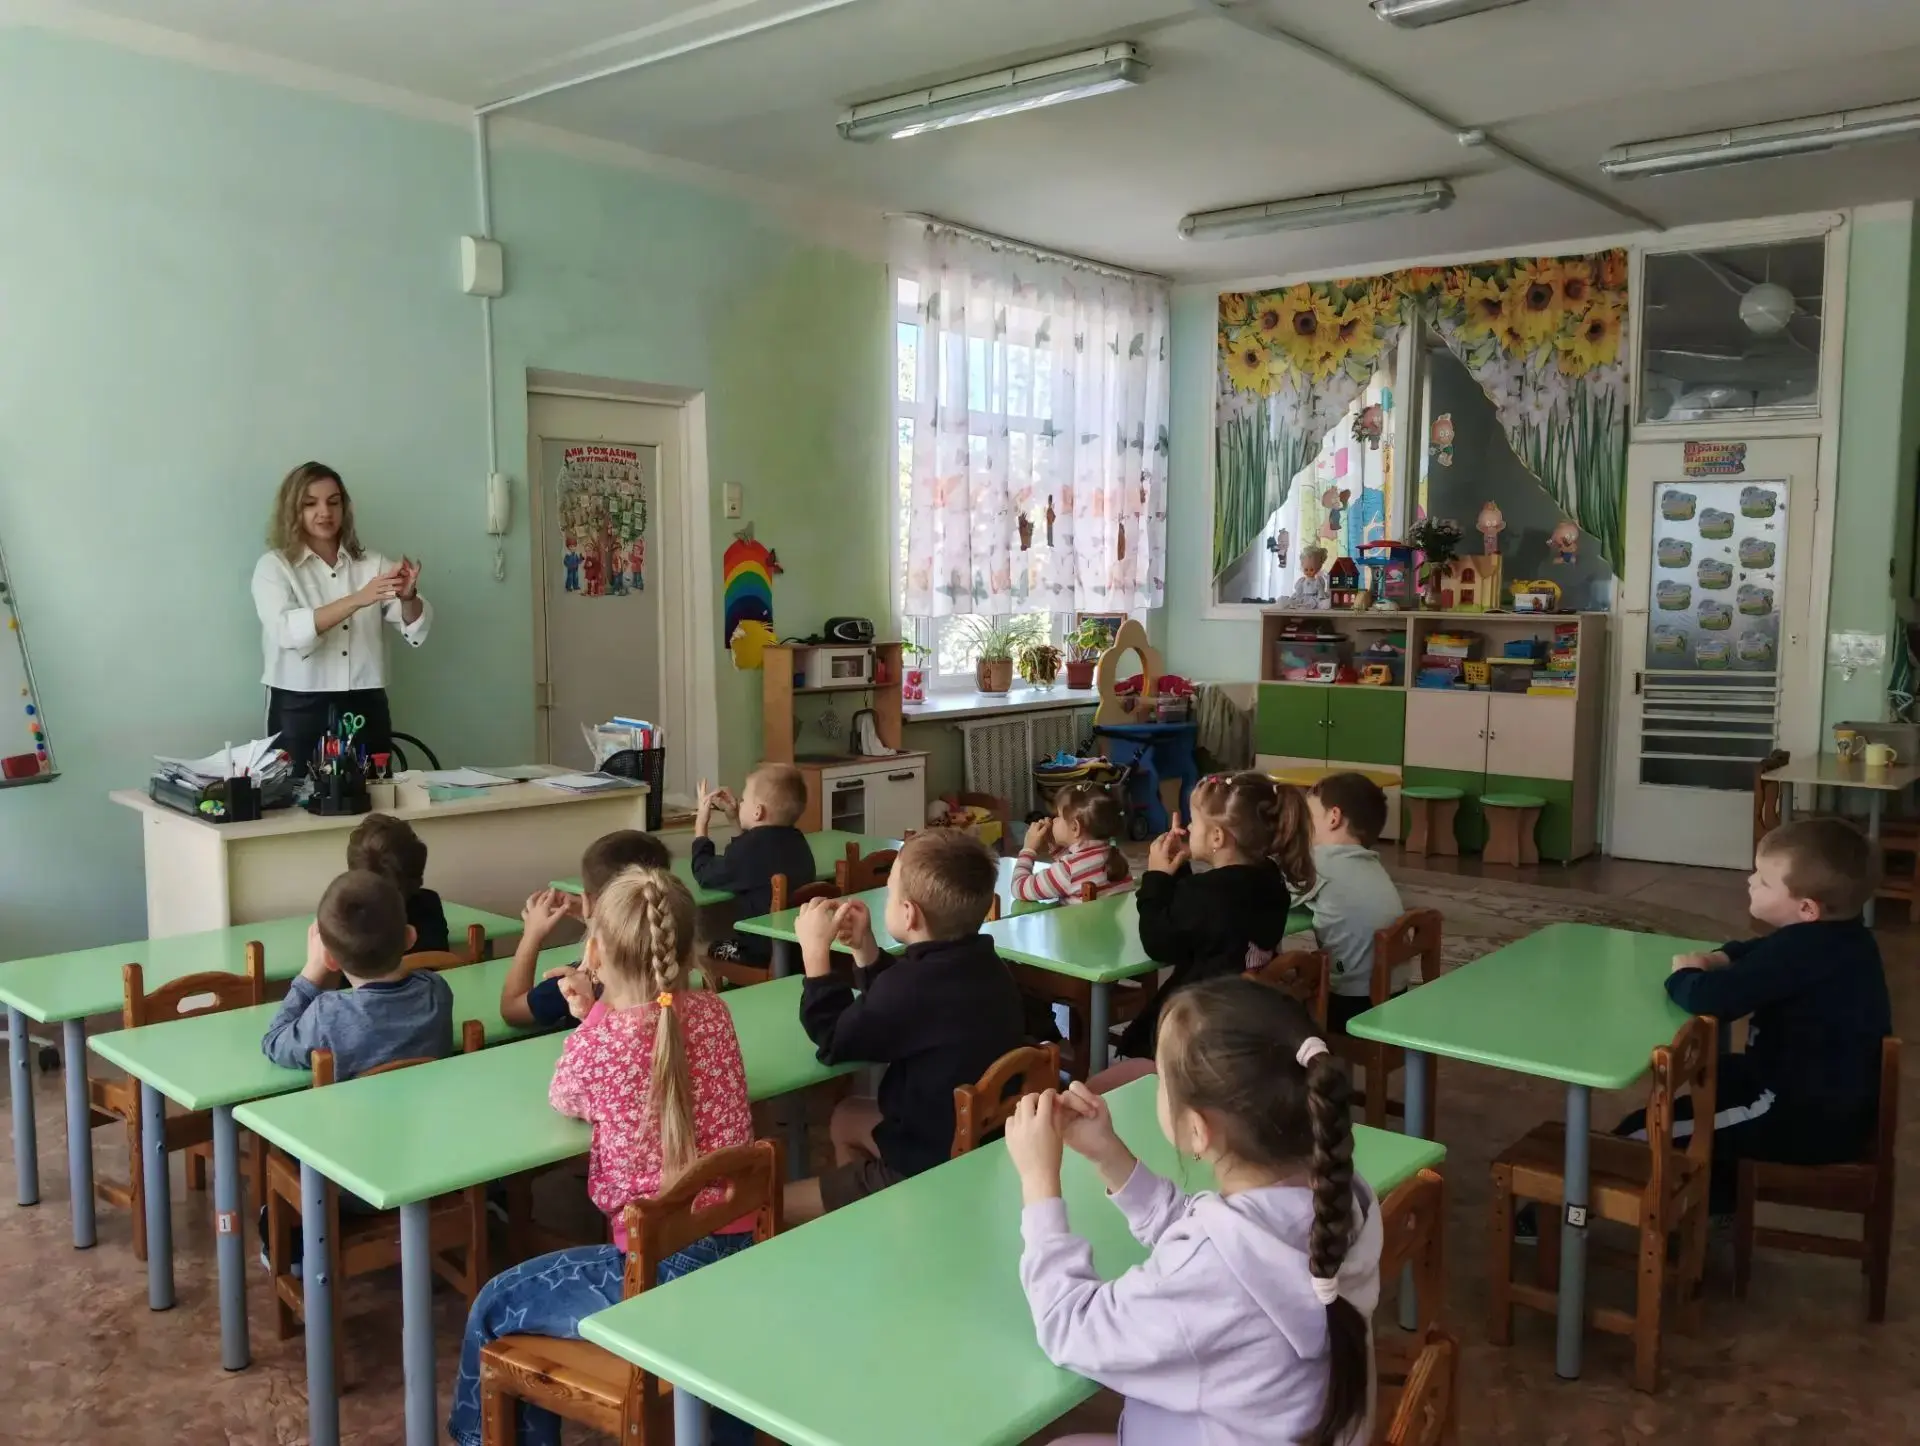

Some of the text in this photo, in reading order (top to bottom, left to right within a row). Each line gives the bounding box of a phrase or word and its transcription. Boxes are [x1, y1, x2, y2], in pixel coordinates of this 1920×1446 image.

[564, 446, 637, 460] ДНИ РОЖДЕНИЯ
[576, 455, 609, 464] КРУГЛЫЙ
[1573, 1211, 1581, 1222] 2
